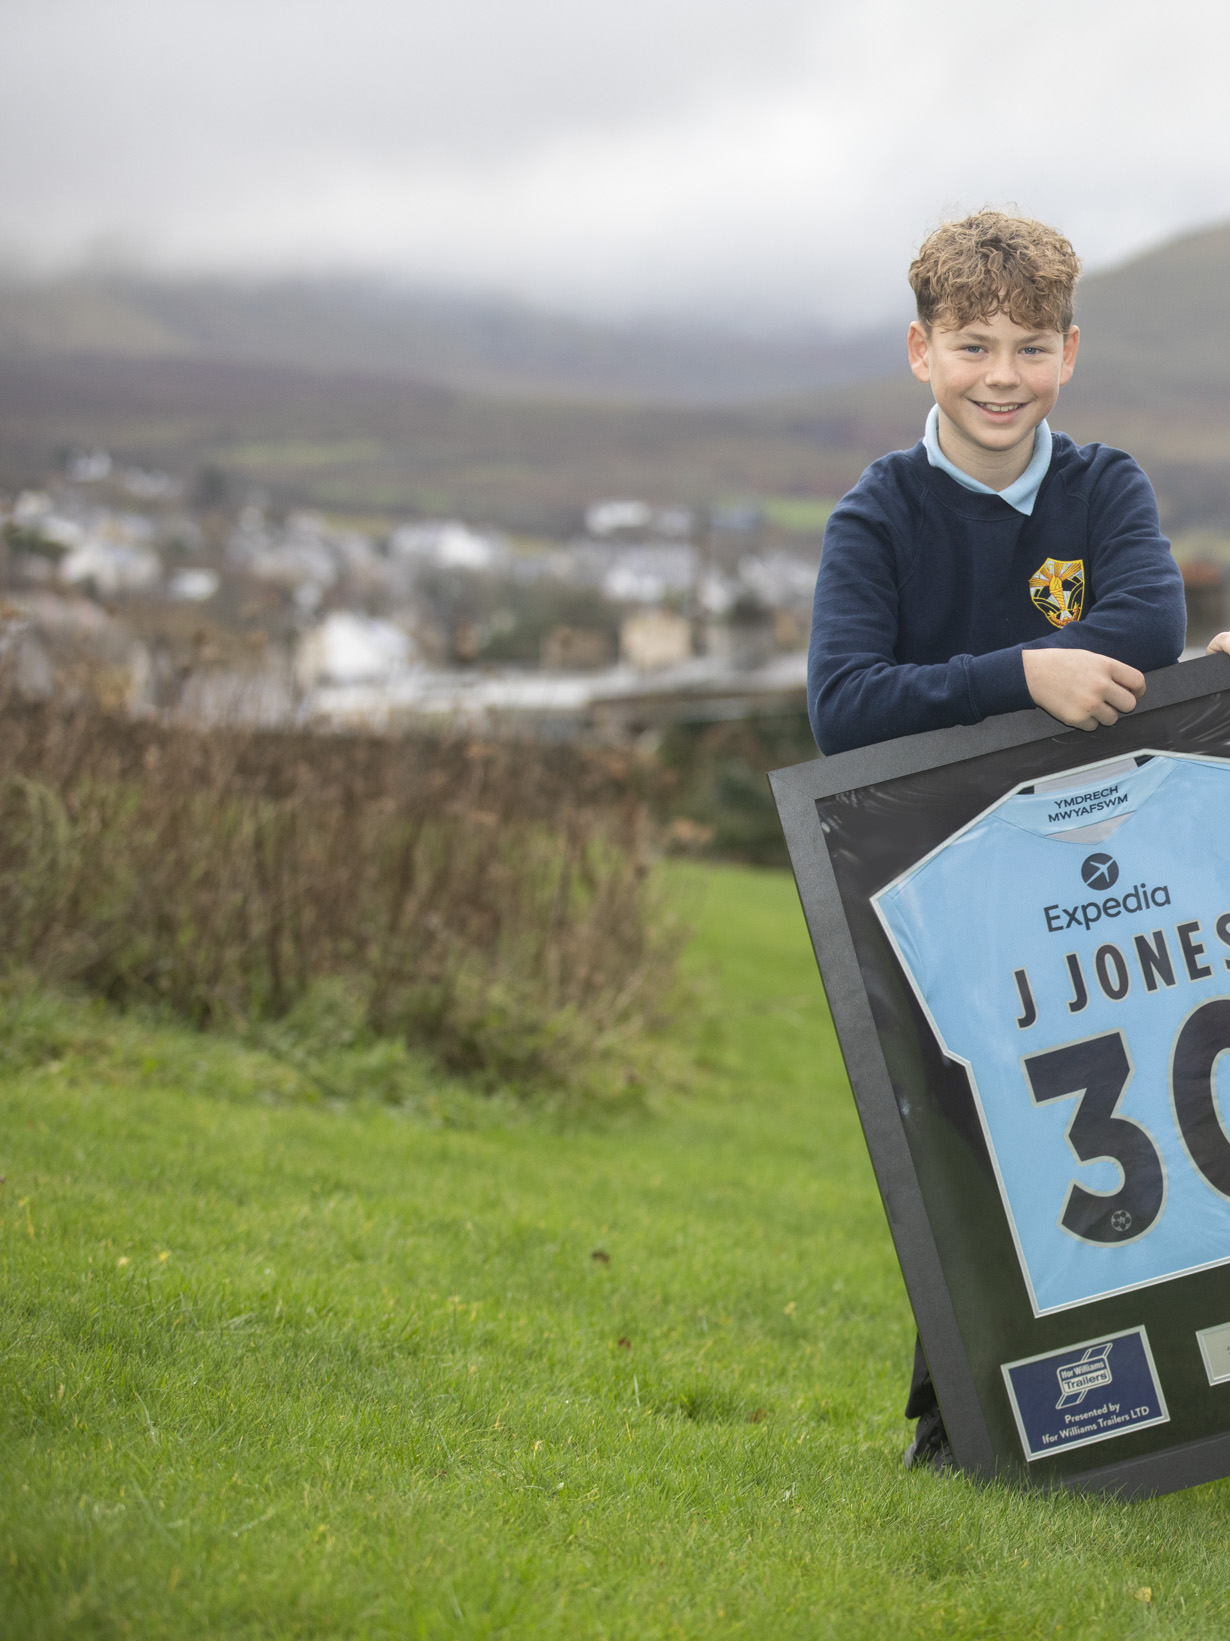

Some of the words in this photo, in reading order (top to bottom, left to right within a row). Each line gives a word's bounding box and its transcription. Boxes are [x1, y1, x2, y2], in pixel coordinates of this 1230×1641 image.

[1048, 794, 1128, 822] MWYAFSWM
[1054, 786, 1118, 808] YMDRECH
[1043, 882, 1171, 932] Expedia
[1012, 968, 1037, 1029] J
[1060, 1370, 1074, 1380] Ifor
[1074, 1362, 1104, 1375] Williams
[1064, 1372, 1108, 1390] Trailers
[1042, 1432, 1058, 1444] Ifor
[1059, 1421, 1097, 1439] Williams
[1098, 1414, 1130, 1428] Trailers
[1130, 1406, 1150, 1418] LTD
[1064, 1404, 1108, 1424] Presented
[1108, 1402, 1120, 1412] by
